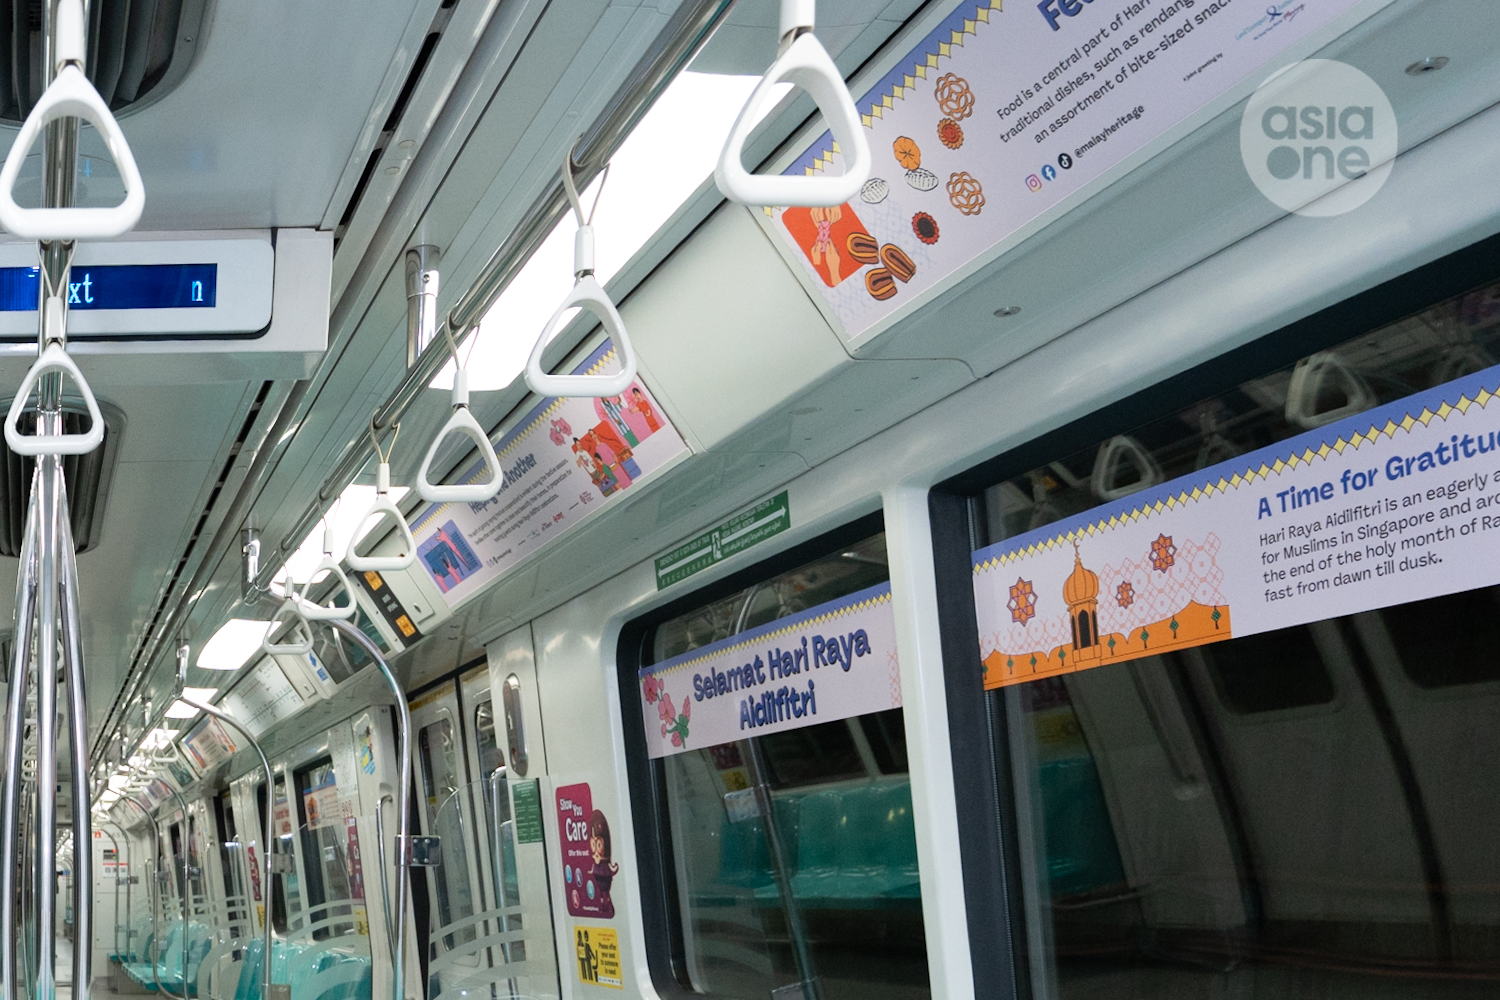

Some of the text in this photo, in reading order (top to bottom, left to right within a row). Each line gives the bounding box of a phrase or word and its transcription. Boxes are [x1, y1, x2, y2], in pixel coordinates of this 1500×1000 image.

[996, 94, 1024, 120] Food
[1022, 88, 1034, 100] is
[1034, 82, 1043, 92] a
[1042, 50, 1082, 85] central
[1083, 28, 1110, 57] part
[1110, 14, 1124, 31] of
[1000, 97, 1056, 143] traditional
[1054, 67, 1096, 102] dishes,
[1093, 45, 1122, 72] such
[1122, 34, 1138, 50] as
[1138, 0, 1195, 38] rendang
[1034, 128, 1050, 144] an
[1048, 79, 1115, 133] assortment
[1114, 66, 1129, 84] of
[1128, 19, 1194, 73] bite-sized
[1194, 0, 1232, 25] snac
[1074, 104, 1145, 159] @malayheritage
[504, 452, 537, 486] Another
[1258, 496, 1272, 520] A
[1276, 482, 1334, 514] Time
[1340, 469, 1378, 495] for
[1259, 528, 1285, 548] Hari
[1288, 518, 1322, 539] Raya
[1325, 499, 1382, 529] Aidilfitri
[1384, 498, 1398, 514] is
[1402, 492, 1422, 508] an
[1426, 472, 1488, 500] eagerly
[1261, 550, 1280, 566] for
[1283, 536, 1338, 561] Muslims
[1340, 531, 1354, 545] in
[1357, 508, 1436, 541] Singapore
[1439, 497, 1472, 520] and
[1263, 568, 1286, 584] the
[1290, 560, 1316, 578] end
[1318, 556, 1333, 572] of
[1336, 548, 1362, 568] the
[1366, 540, 1397, 562] holy
[1401, 526, 1455, 551] month
[1459, 518, 1478, 536] of
[1264, 550, 1444, 603] fast from dawn till dusk.
[693, 628, 871, 702] Selamat Hari Raya
[739, 679, 817, 731] Aidilfitri
[560, 798, 573, 811] Show
[565, 817, 588, 842] Care
[572, 804, 582, 816] You
